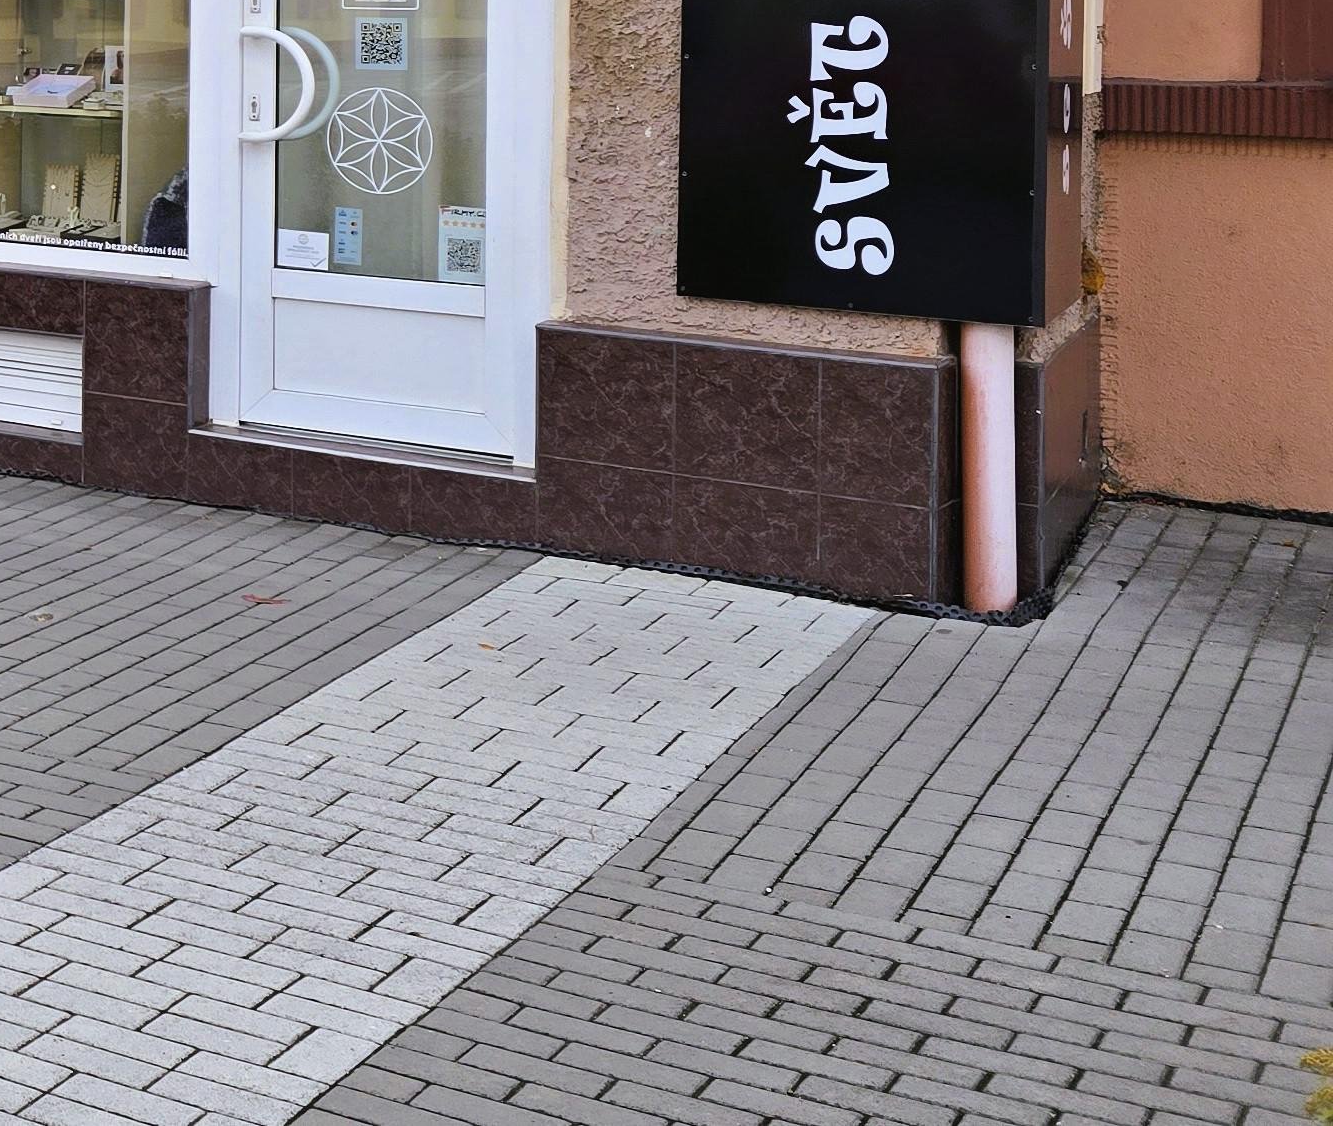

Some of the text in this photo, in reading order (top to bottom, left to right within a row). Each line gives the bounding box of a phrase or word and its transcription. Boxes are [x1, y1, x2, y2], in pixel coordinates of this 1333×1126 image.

[785, 13, 895, 276] SVĚT
[42, 234, 62, 245] jsou
[63, 237, 104, 251] opatřeny
[105, 240, 167, 256] bezpečnostní
